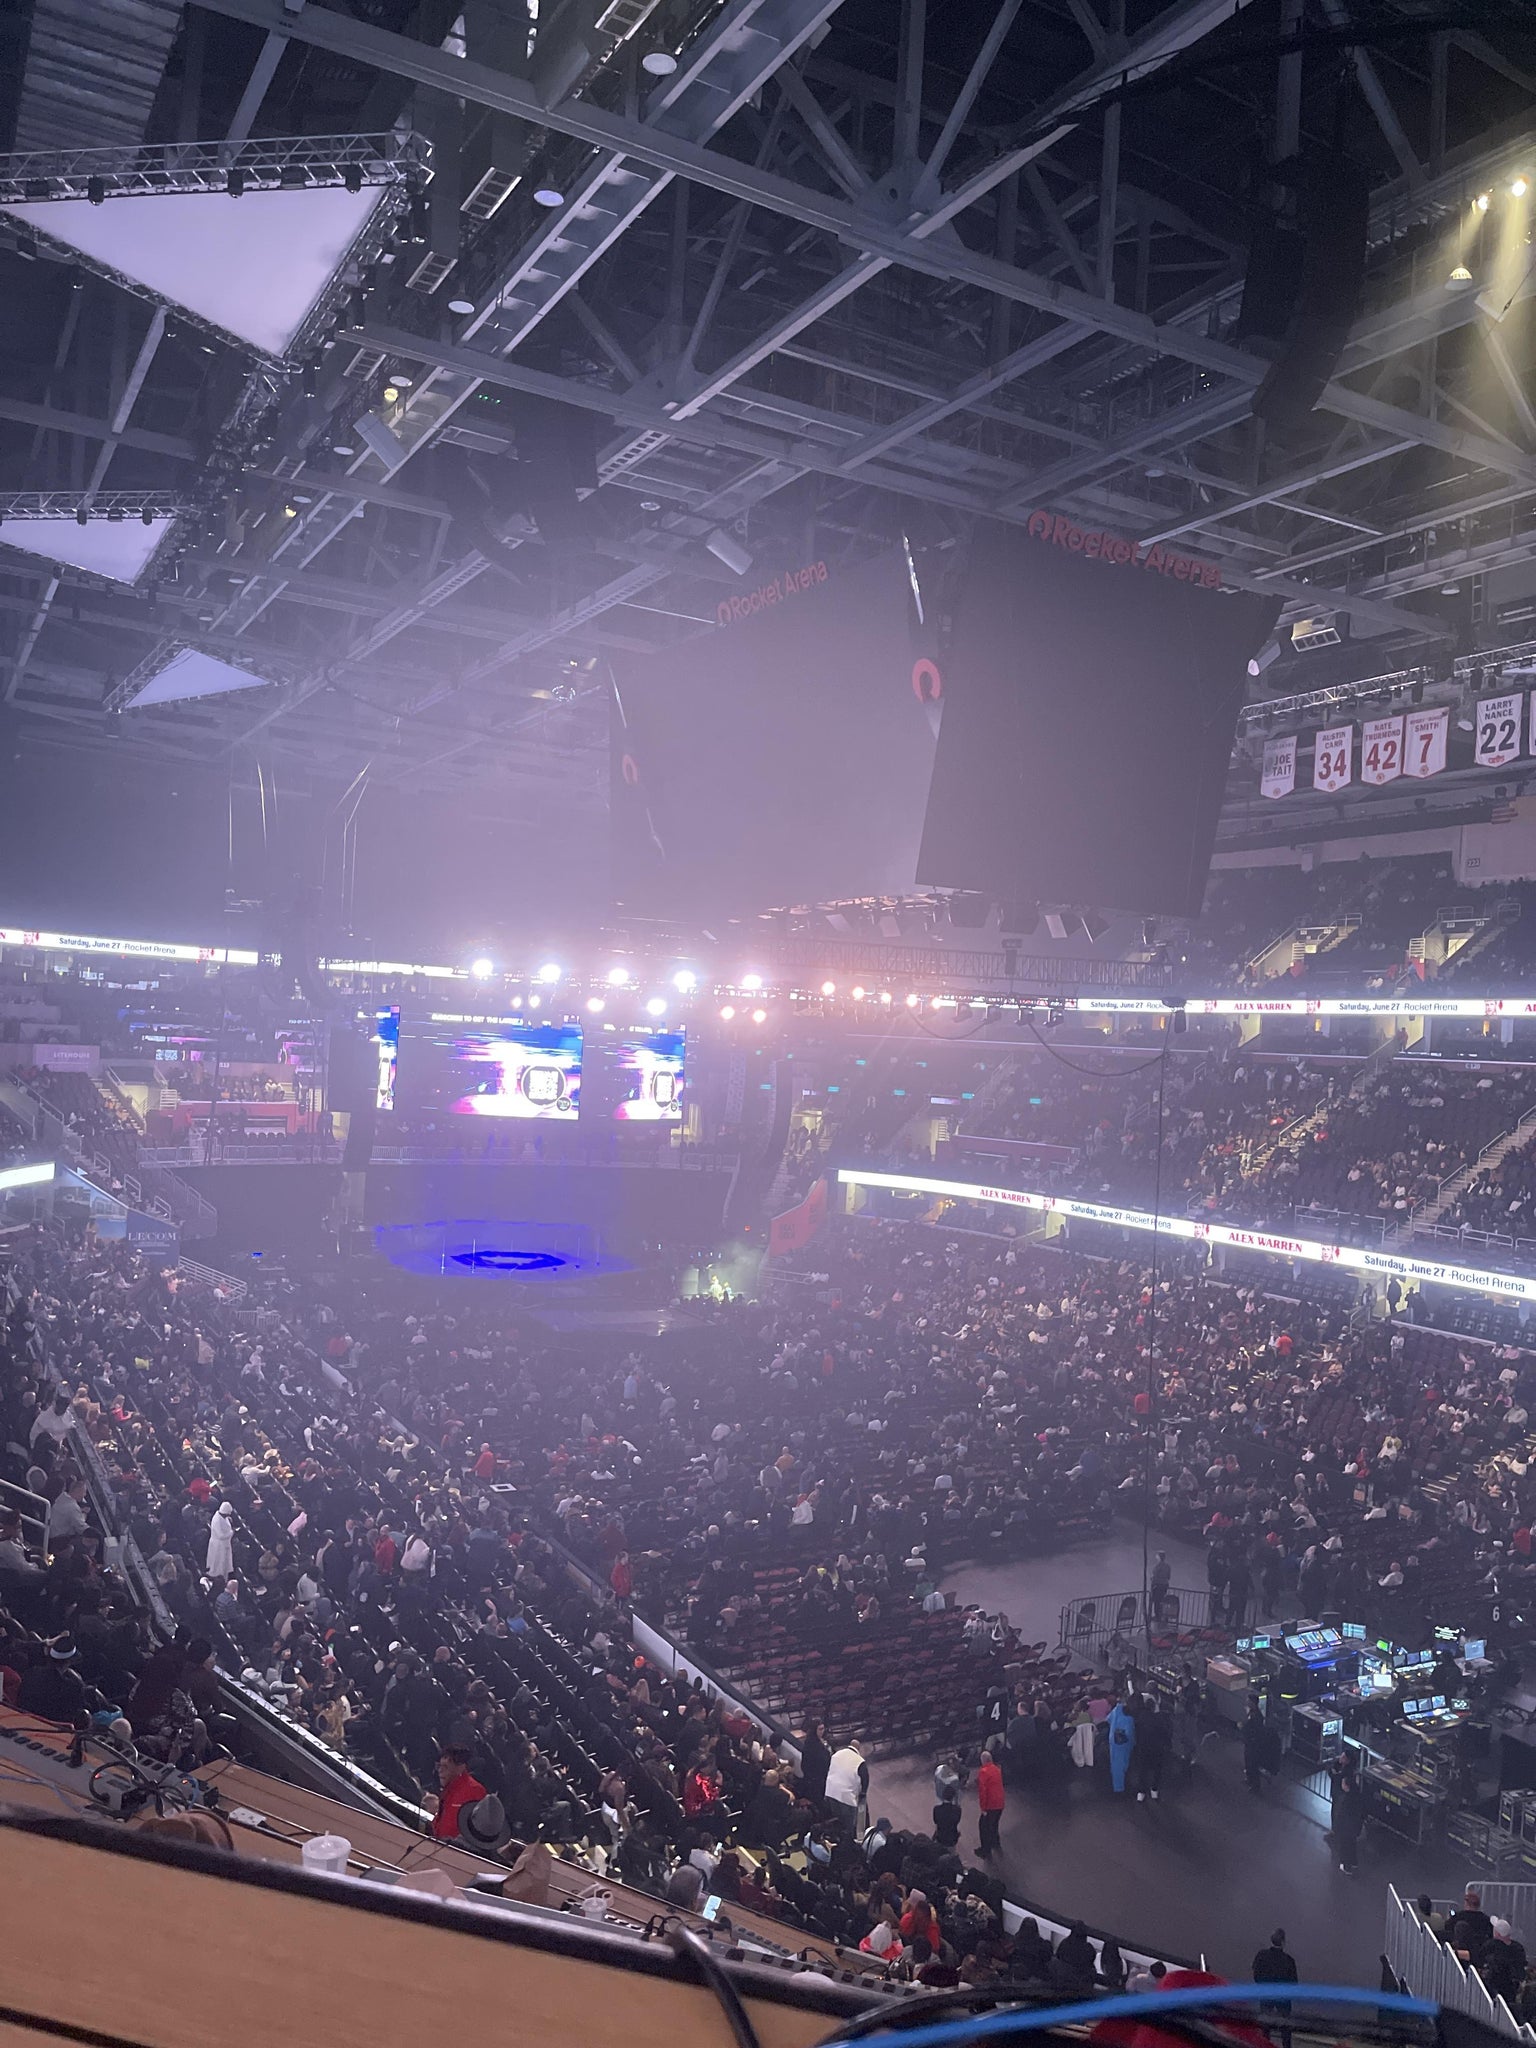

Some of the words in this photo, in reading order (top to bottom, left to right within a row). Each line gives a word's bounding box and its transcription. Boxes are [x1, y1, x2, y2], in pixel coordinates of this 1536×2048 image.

[1052, 515, 1141, 566] Rocket
[1144, 543, 1222, 589] Arena
[730, 578, 783, 619] Rocket
[784, 560, 828, 593] Arena
[1485, 699, 1513, 712] LARRY
[1484, 708, 1513, 720] NANCE
[1374, 721, 1393, 731] NATE
[1414, 722, 1439, 733] SMITH
[1322, 731, 1346, 742] AUSTIN
[1324, 740, 1343, 749] CARR
[1480, 719, 1516, 754] 22
[1365, 740, 1397, 772] 42
[1419, 733, 1433, 764] 7
[1273, 753, 1292, 766] JOE
[1318, 749, 1347, 780] 34
[1272, 764, 1292, 777] TAIT
[59, 937, 91, 948] Saturday,
[92, 940, 110, 949] June
[153, 946, 176, 955] Arena
[1090, 1001, 1118, 1009] Saturday,
[1339, 1003, 1372, 1012] Saturday,
[1372, 1003, 1390, 1011] June
[1391, 1003, 1400, 1011] 27
[979, 1188, 999, 1199] ALEX
[1001, 1191, 1031, 1204] WARREN
[1070, 1204, 1098, 1217] Saturday,
[1098, 1207, 1114, 1218] June
[1114, 1211, 1123, 1220] 27
[1228, 1232, 1255, 1244] ALEX
[1257, 1236, 1303, 1253] WARREN
[1364, 1255, 1407, 1273] Saturday,
[1408, 1263, 1431, 1275] June
[1433, 1267, 1446, 1278] 27
[1492, 1277, 1525, 1293] Arena
[693, 1398, 700, 1410] 2
[1492, 1606, 1500, 1622] 6
[991, 1701, 1001, 1721] 4
